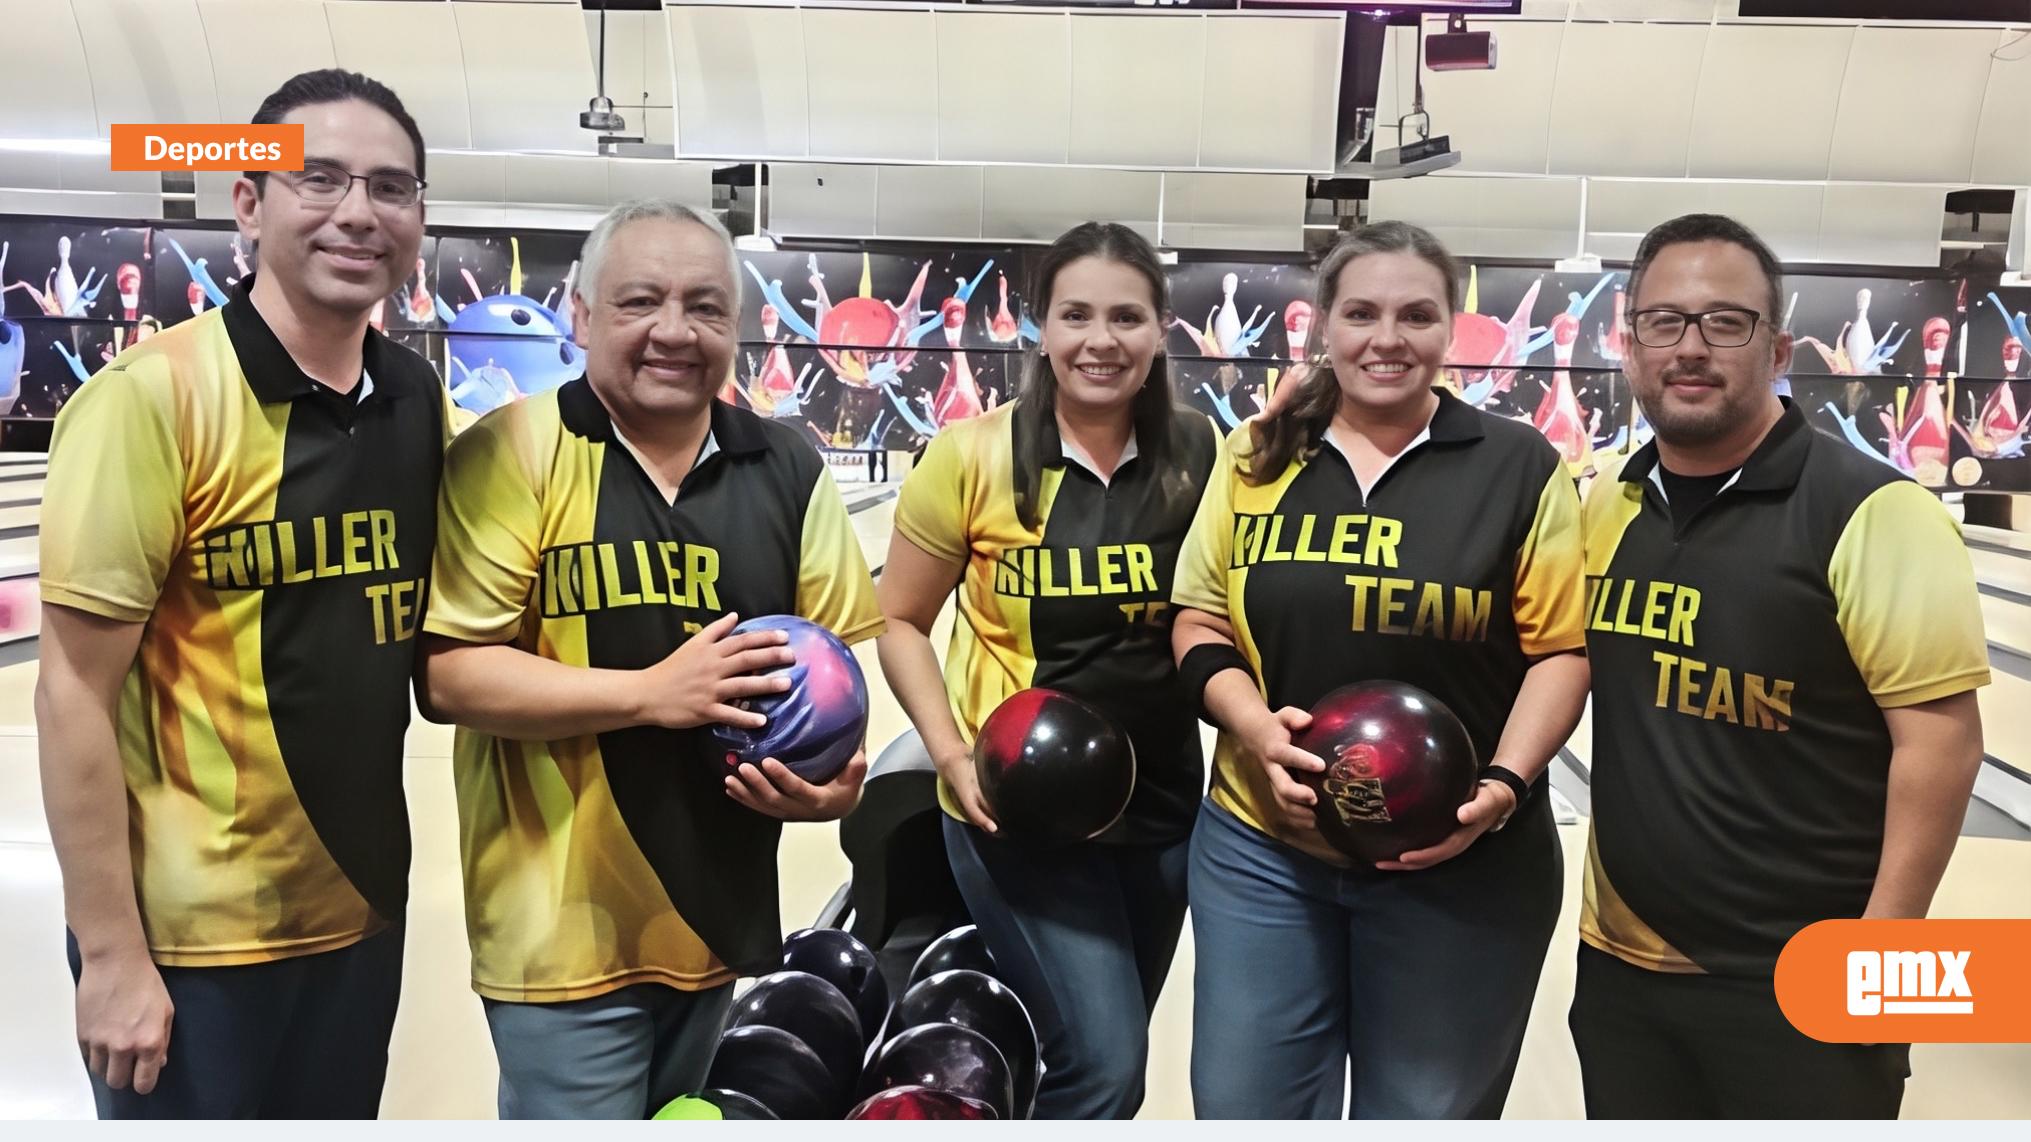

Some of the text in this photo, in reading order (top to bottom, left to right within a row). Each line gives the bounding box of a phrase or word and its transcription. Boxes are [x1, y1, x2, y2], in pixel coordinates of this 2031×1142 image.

[545, 540, 721, 615] KILLER
[1345, 574, 1492, 642] TEAM
[1584, 577, 1701, 647] ILLER
[1653, 651, 1795, 732] TEAM
